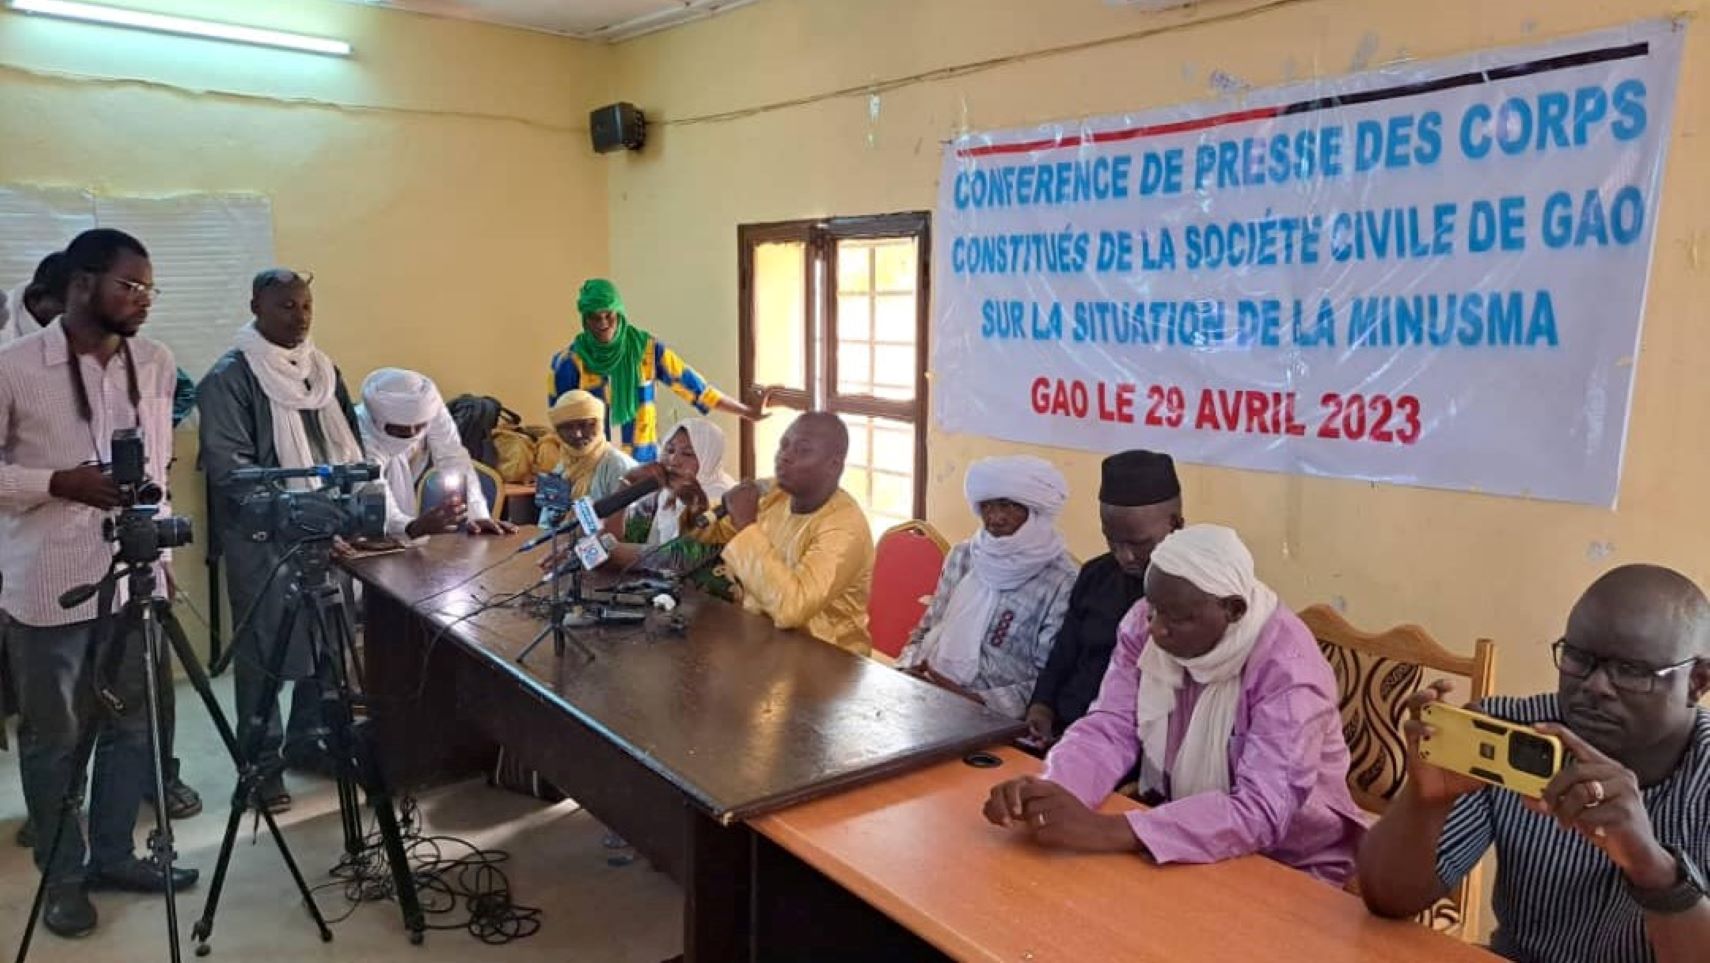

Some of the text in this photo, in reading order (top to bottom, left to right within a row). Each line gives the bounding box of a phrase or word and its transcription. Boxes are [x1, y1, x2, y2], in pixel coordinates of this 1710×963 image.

[954, 79, 1648, 210] CONFERENCE DE PRESSE DES CORPS
[953, 223, 1090, 274] CONSTITUÉS
[1096, 230, 1133, 274] DE
[1142, 227, 1176, 272] LA
[1331, 203, 1457, 262] CIVILE
[1468, 196, 1526, 254] DE
[1542, 185, 1645, 249] GAO
[981, 289, 1559, 348] SUR LA SITUATION DE LA MINUSMA
[1031, 376, 1421, 445] GAO LE 29 AVRIL 2023
